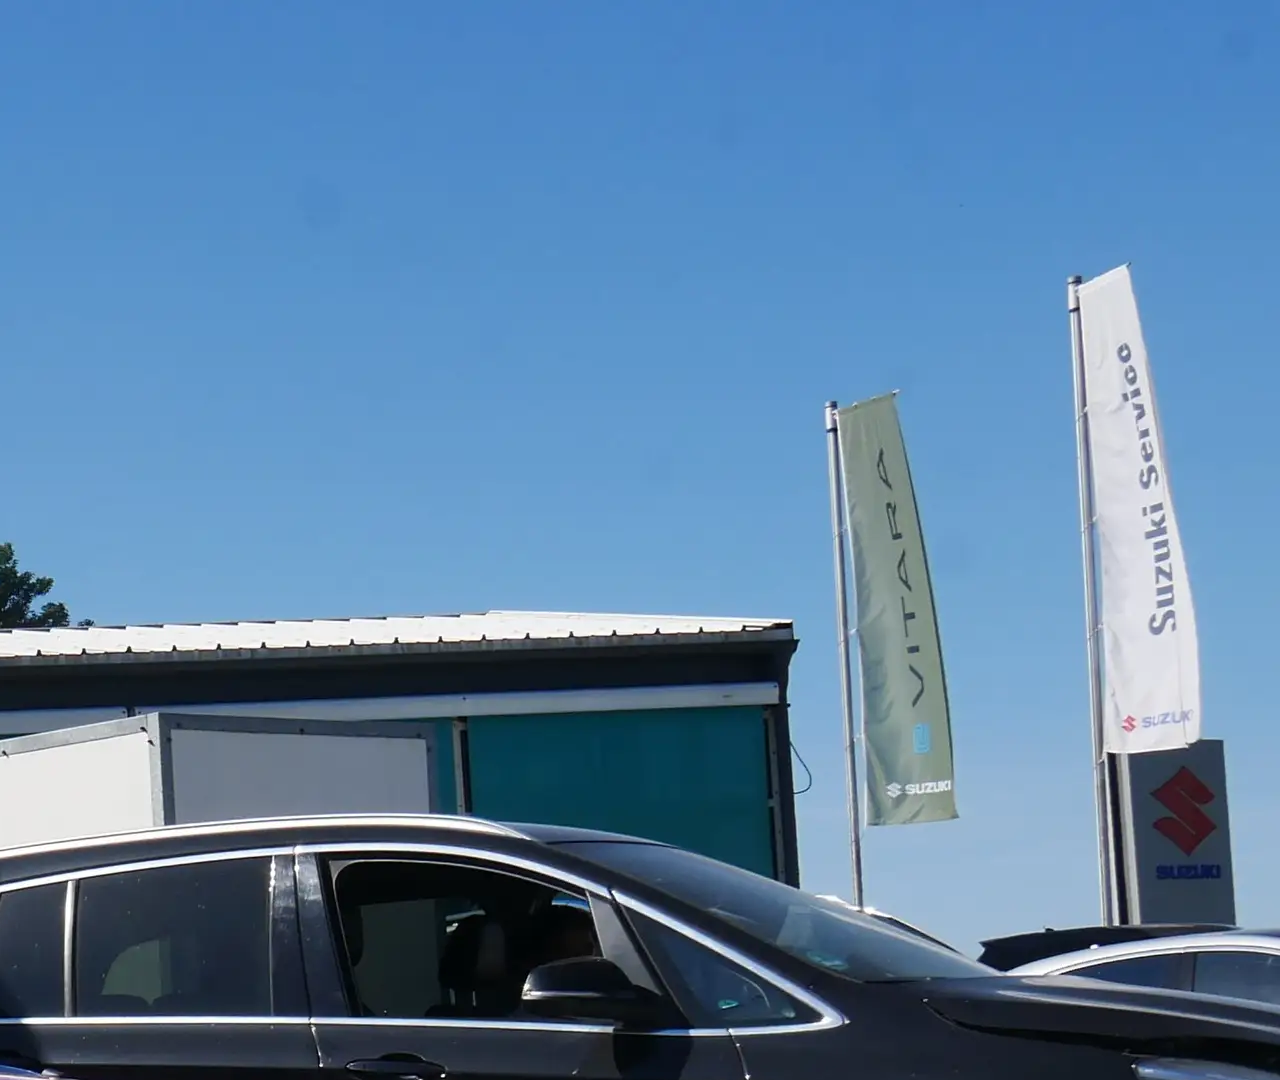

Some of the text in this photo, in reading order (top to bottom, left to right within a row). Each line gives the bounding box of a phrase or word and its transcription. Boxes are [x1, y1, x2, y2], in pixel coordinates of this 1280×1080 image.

[875, 448, 926, 709] VITARA
[1116, 341, 1178, 636] Suzuki Service
[904, 780, 952, 795] SUZUKI
